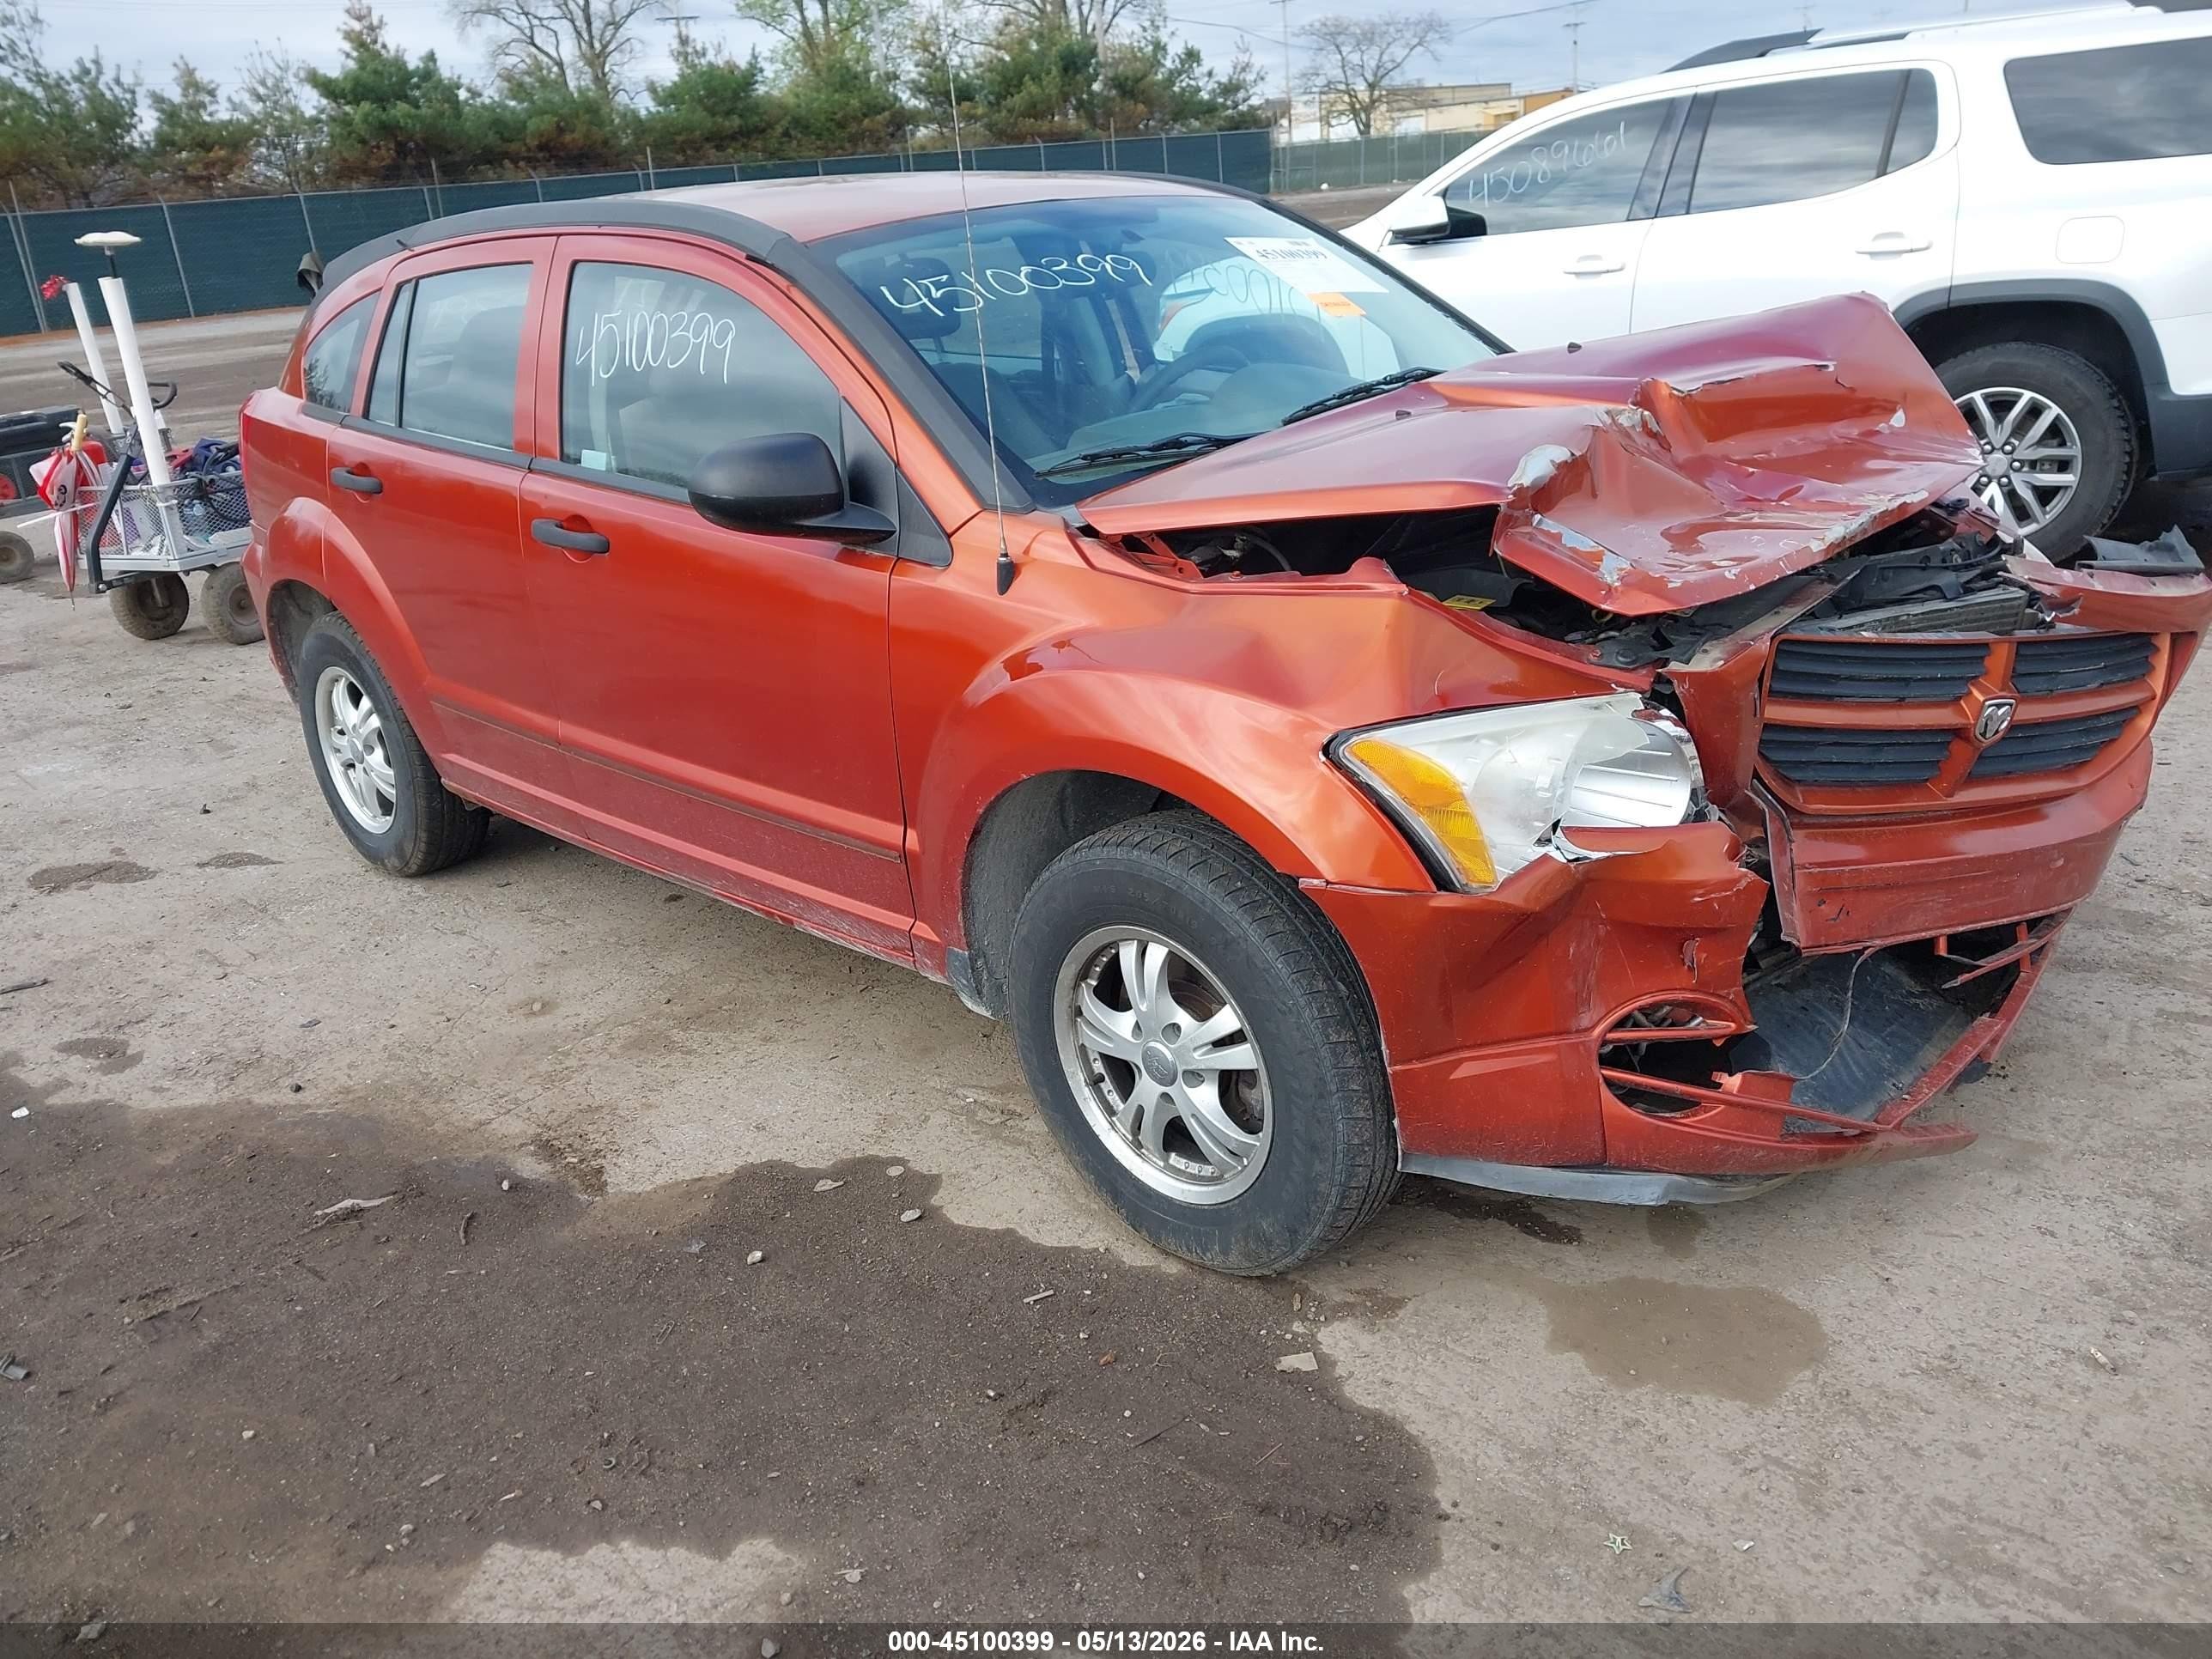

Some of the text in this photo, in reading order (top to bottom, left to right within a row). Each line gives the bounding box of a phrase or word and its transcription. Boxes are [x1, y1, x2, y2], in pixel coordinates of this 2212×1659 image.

[1468, 120, 1626, 208] 45089661
[879, 253, 1153, 317] 45100399
[575, 309, 736, 387] 45100399
